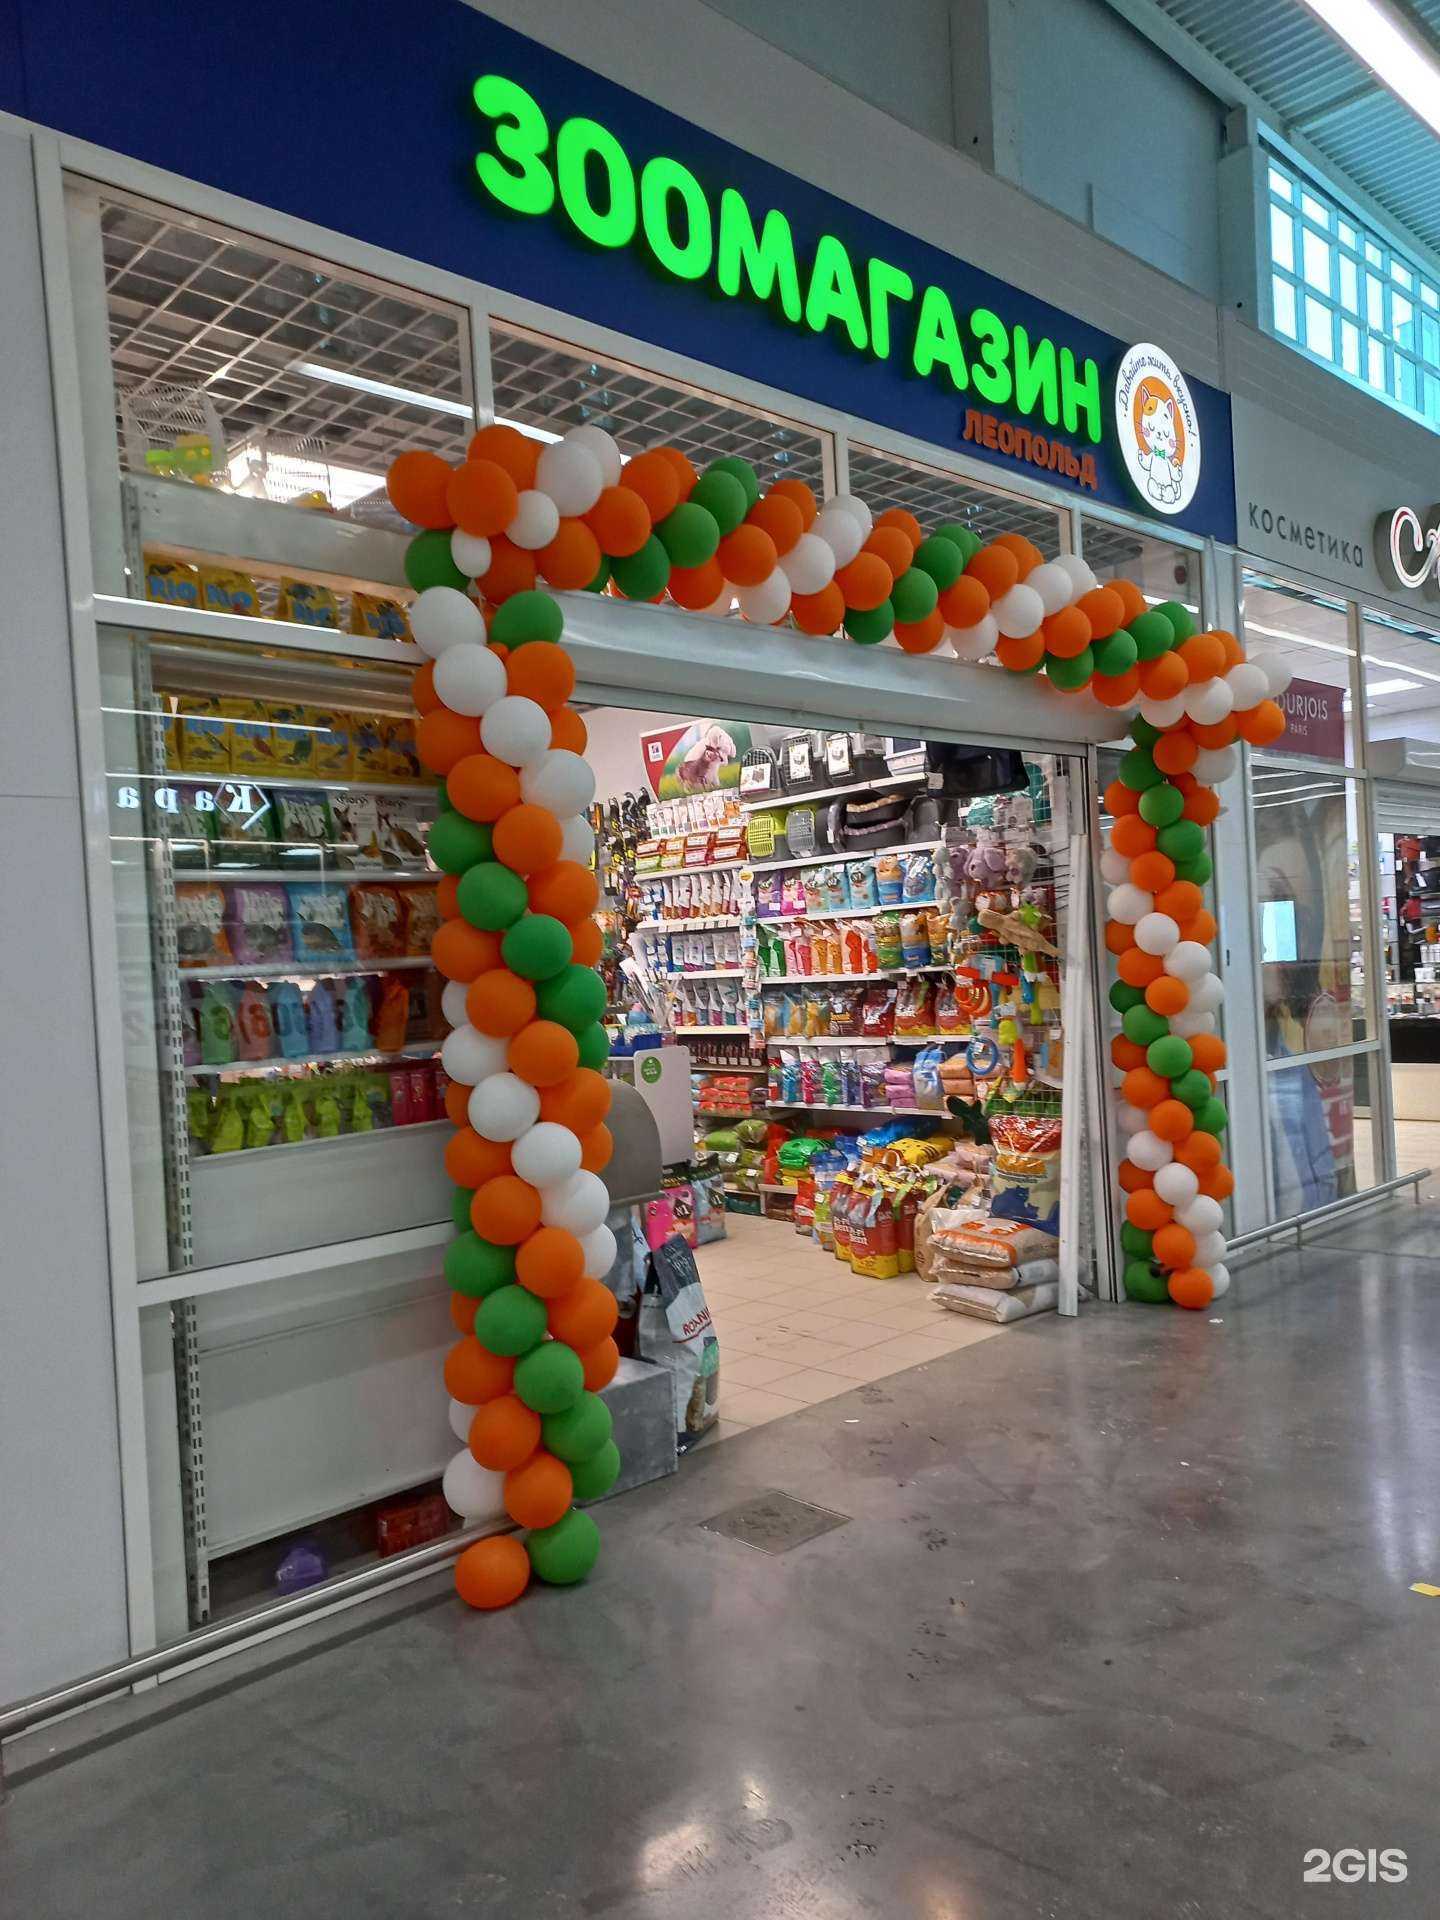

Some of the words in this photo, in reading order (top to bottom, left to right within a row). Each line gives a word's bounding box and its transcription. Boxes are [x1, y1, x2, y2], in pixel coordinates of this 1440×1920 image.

[473, 74, 1101, 443] ЗООМАГАЗИН
[963, 408, 1098, 492] ЛЕОПОЛЬД
[1275, 692, 1328, 720] OURJOIS
